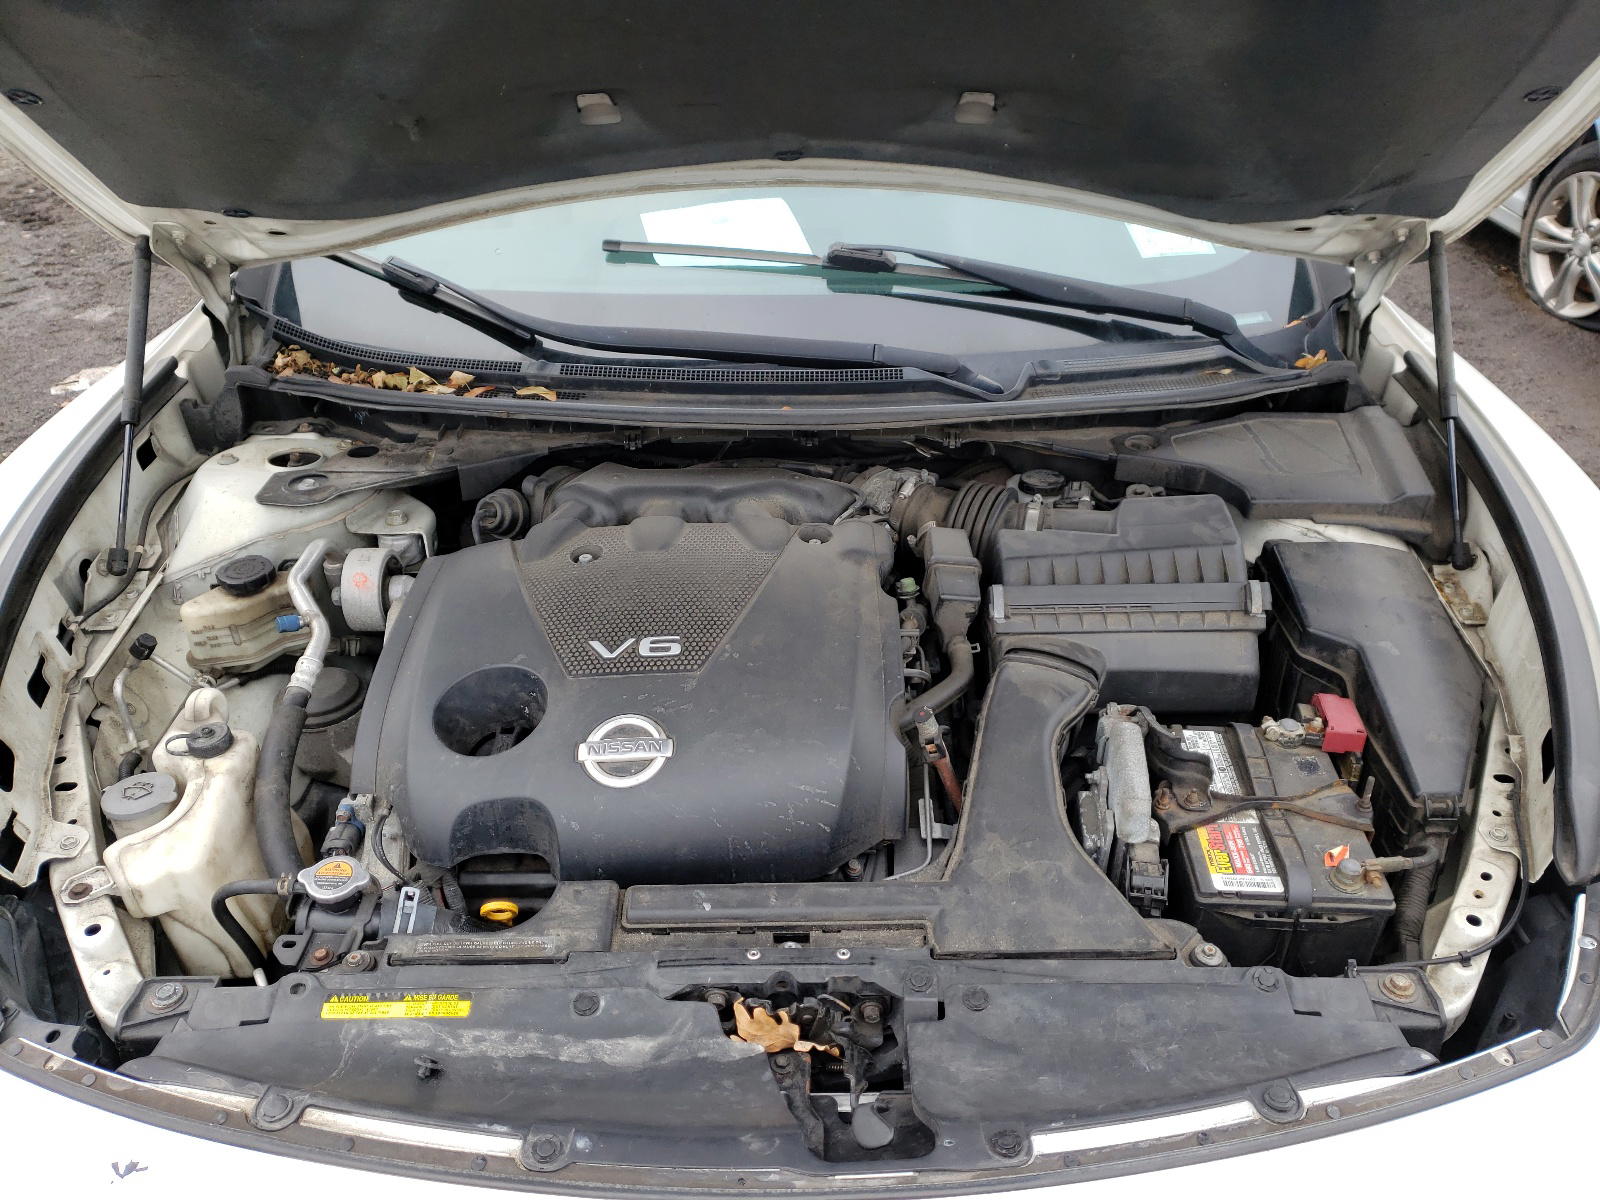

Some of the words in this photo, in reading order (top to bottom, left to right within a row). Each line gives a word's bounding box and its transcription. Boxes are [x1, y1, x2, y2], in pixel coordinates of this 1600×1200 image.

[588, 635, 683, 660] V6
[587, 739, 663, 756] NISSAN
[339, 995, 369, 1003] CAUTION
